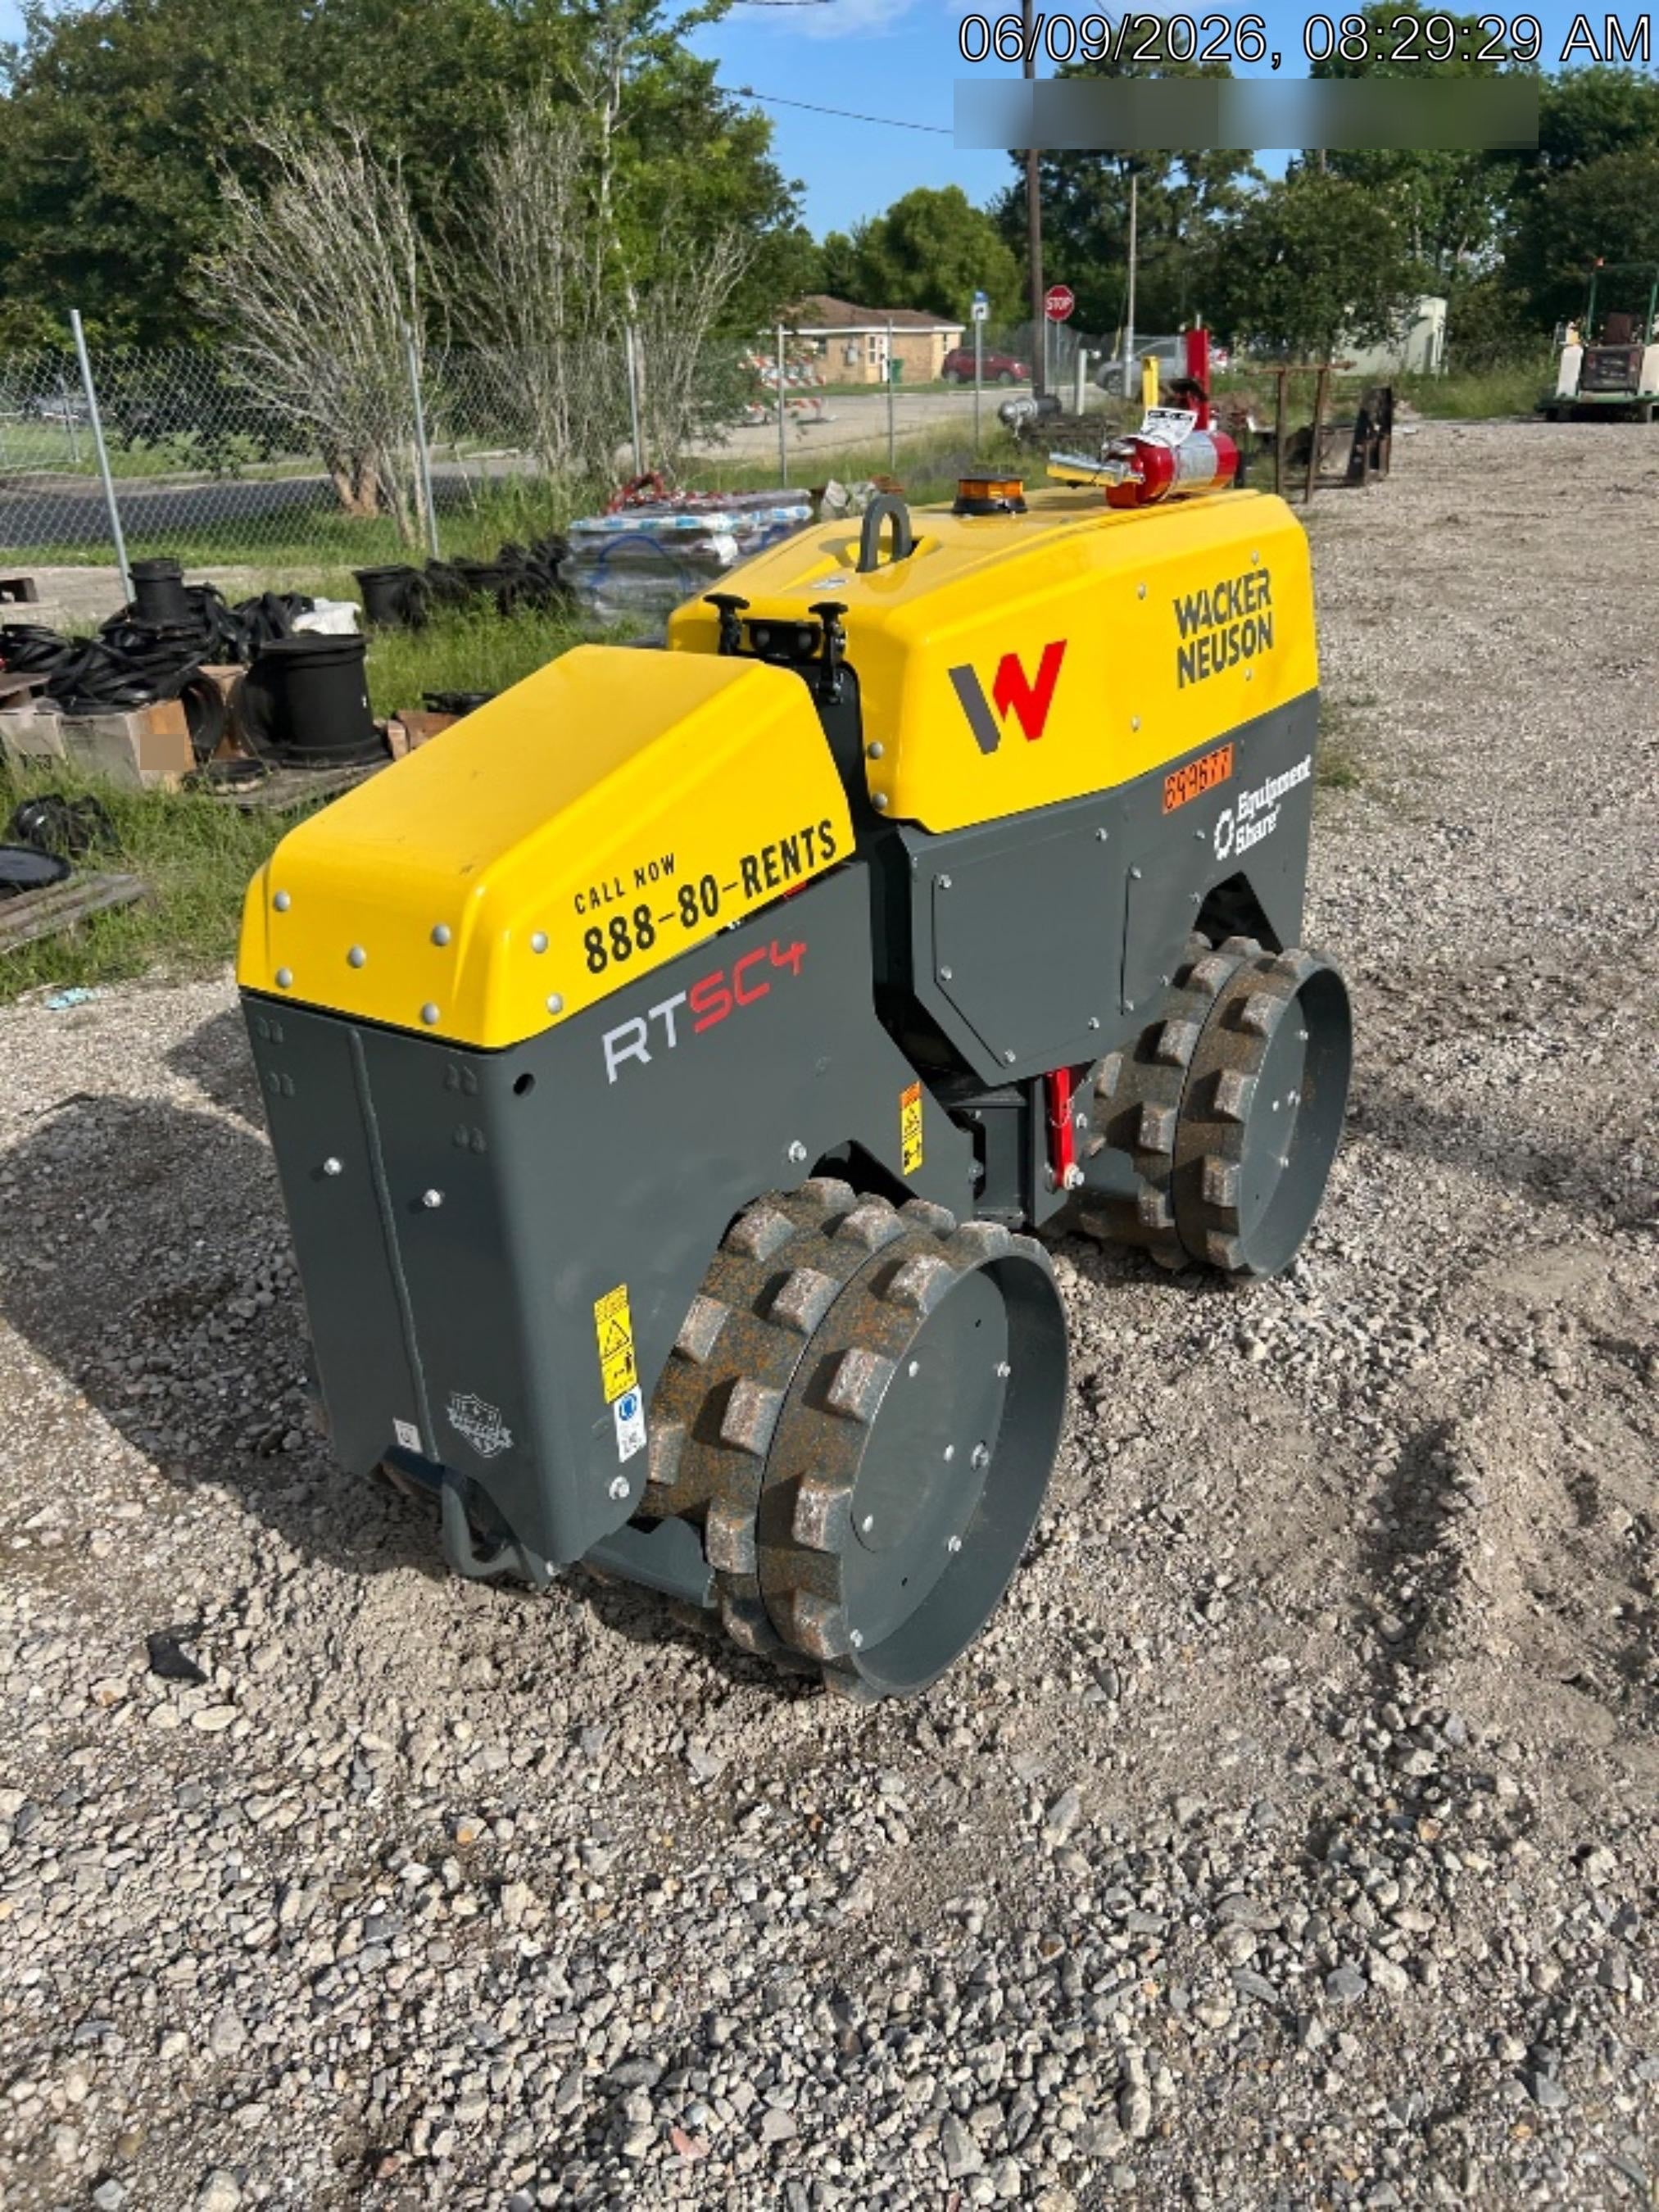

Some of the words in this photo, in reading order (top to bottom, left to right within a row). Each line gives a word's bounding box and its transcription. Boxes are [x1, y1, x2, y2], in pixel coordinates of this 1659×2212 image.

[1047, 297, 1072, 310] STOP
[1172, 568, 1271, 639] WACKER
[1177, 611, 1273, 689] NEUSON
[1236, 754, 1312, 822] Equipment
[1235, 812, 1278, 855] Share
[574, 877, 625, 915] CALL
[633, 853, 676, 888] NOW
[583, 819, 836, 974] 888-80-RENTS
